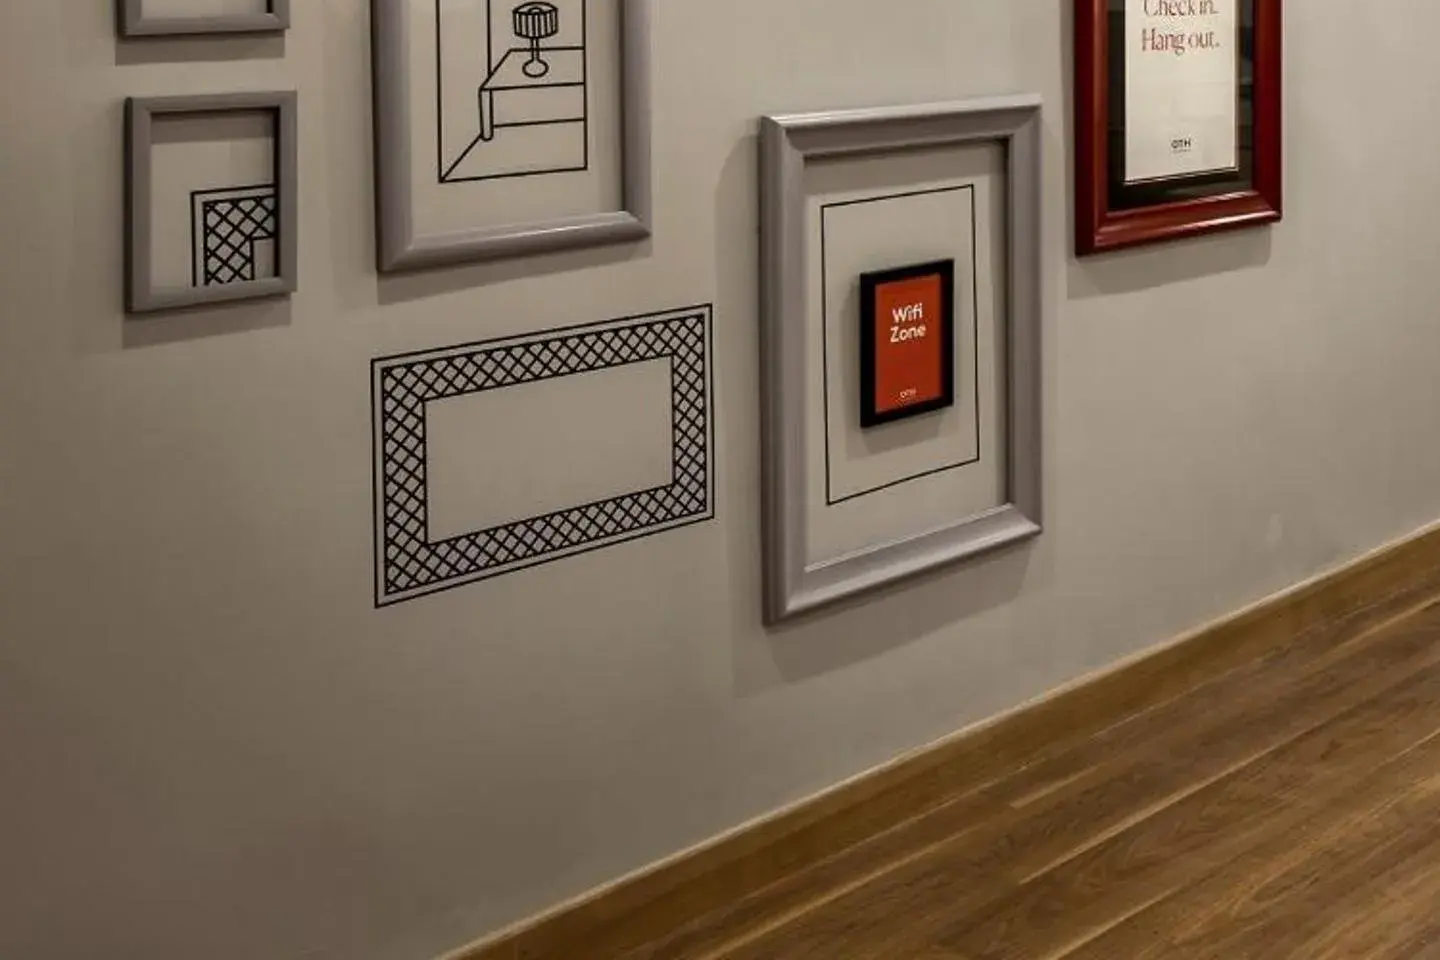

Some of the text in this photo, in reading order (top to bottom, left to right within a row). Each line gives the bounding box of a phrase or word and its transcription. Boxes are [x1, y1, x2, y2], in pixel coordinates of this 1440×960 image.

[1141, 27, 1221, 57] Hang out.
[892, 302, 923, 324] Wifi
[890, 325, 926, 343] Zone
